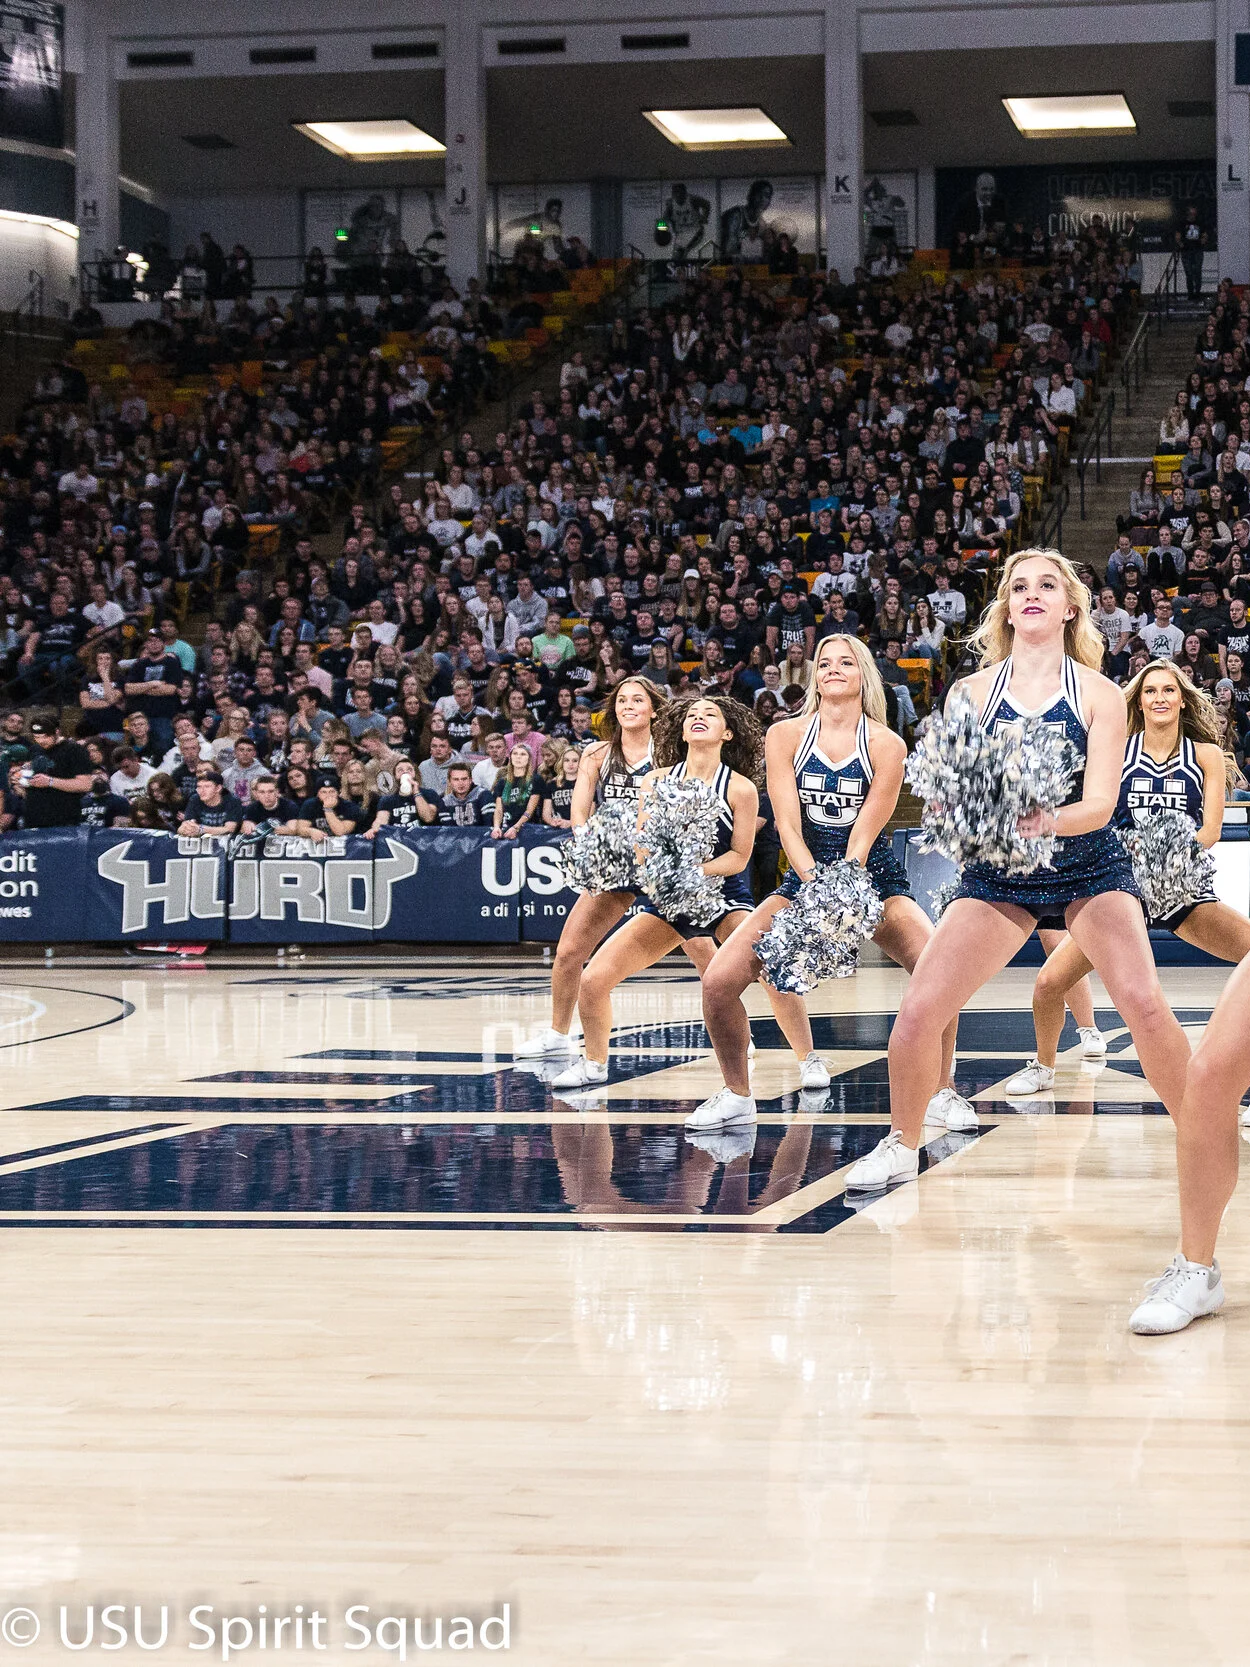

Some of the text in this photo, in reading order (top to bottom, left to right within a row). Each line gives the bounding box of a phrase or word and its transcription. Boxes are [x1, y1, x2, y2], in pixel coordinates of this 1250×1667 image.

[1228, 164, 1241, 182] L
[834, 175, 850, 193] K
[454, 187, 467, 205] J
[83, 200, 98, 216] H
[781, 629, 805, 641] TRUE
[798, 788, 865, 809] STATE
[1127, 792, 1188, 811] STATE
[0, 850, 38, 873] dit
[481, 846, 581, 896] US
[0, 880, 39, 898] on
[98, 837, 420, 934] HURD
